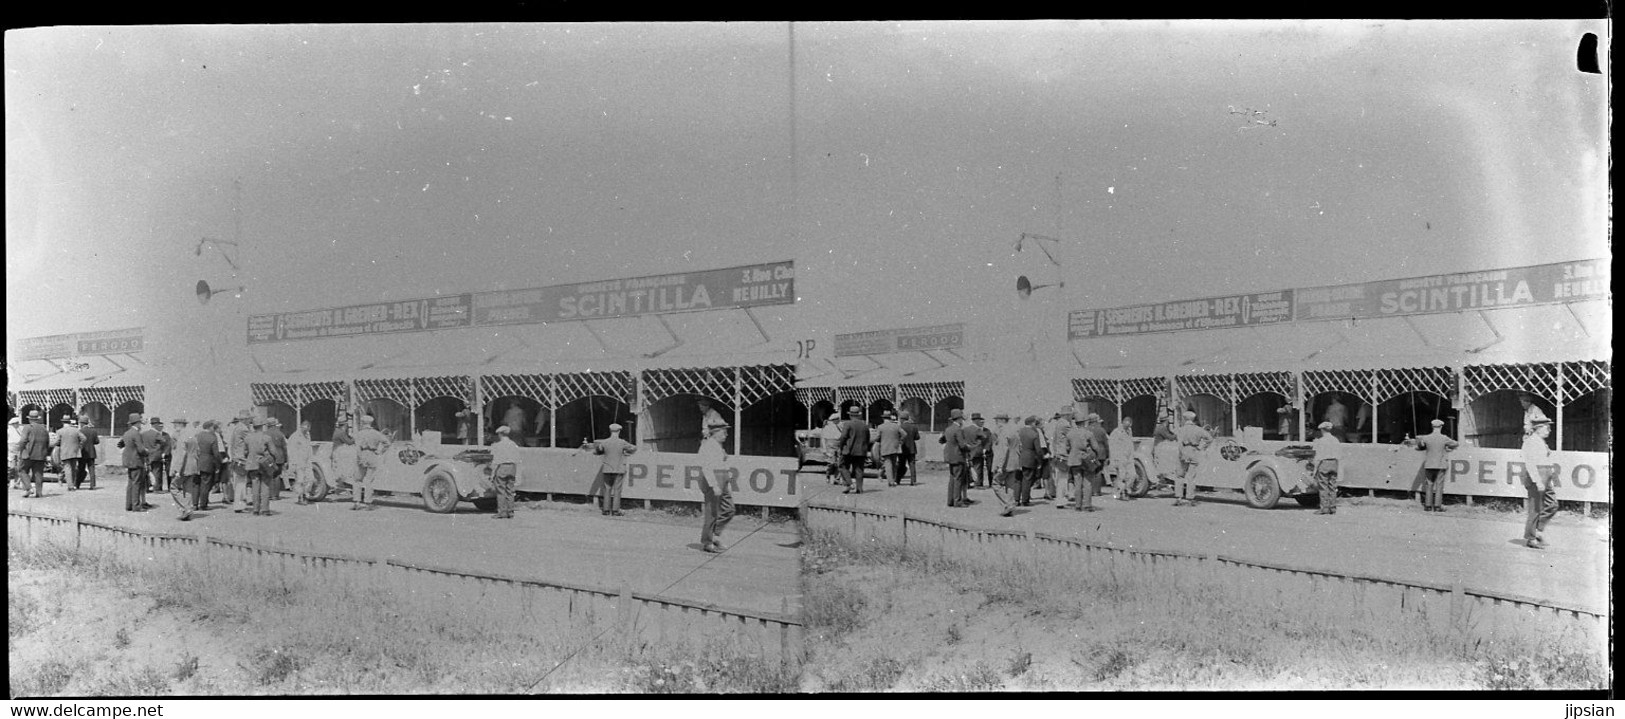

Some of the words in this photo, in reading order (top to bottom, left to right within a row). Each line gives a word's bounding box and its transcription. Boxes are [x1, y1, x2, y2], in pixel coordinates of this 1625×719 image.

[559, 284, 712, 318] SCINTILLA
[733, 282, 789, 303] NEUILLY
[1380, 280, 1534, 314] SCINTILLA
